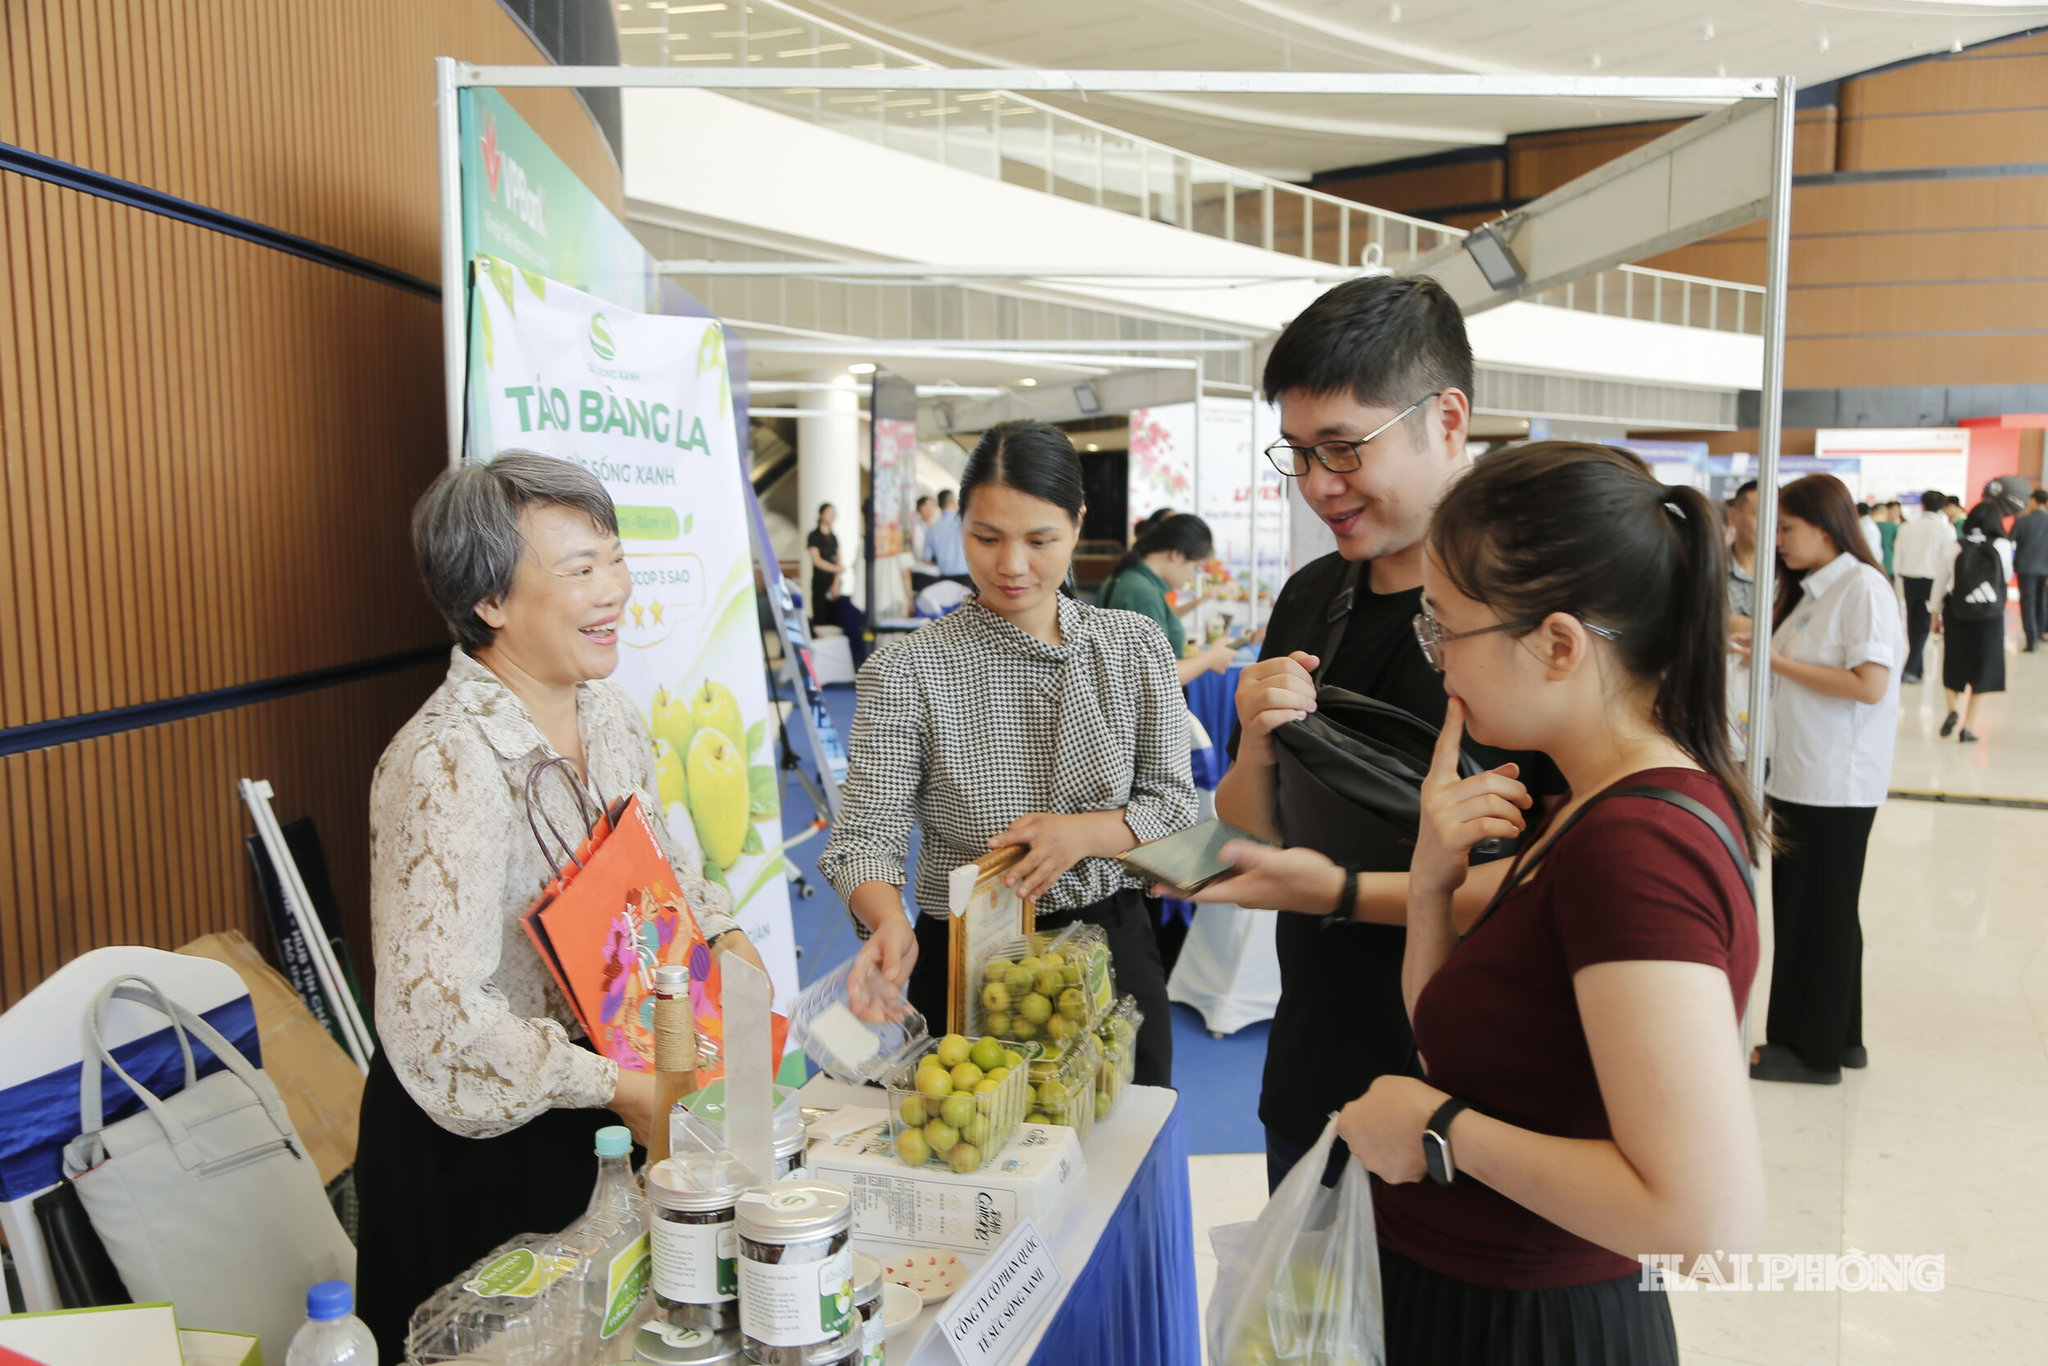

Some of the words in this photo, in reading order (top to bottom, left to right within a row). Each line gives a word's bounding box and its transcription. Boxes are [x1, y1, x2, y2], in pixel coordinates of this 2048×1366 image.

[504, 373, 571, 432] TÁO
[579, 385, 670, 443] BÀNG
[675, 409, 712, 456] LA
[591, 454, 631, 484] SỐNG
[635, 465, 676, 485] XANH
[660, 570, 666, 584] 3
[669, 570, 690, 584] SAO
[291, 930, 309, 965] HUB
[954, 1307, 979, 1341] CÔNG
[977, 1294, 989, 1313] TY
